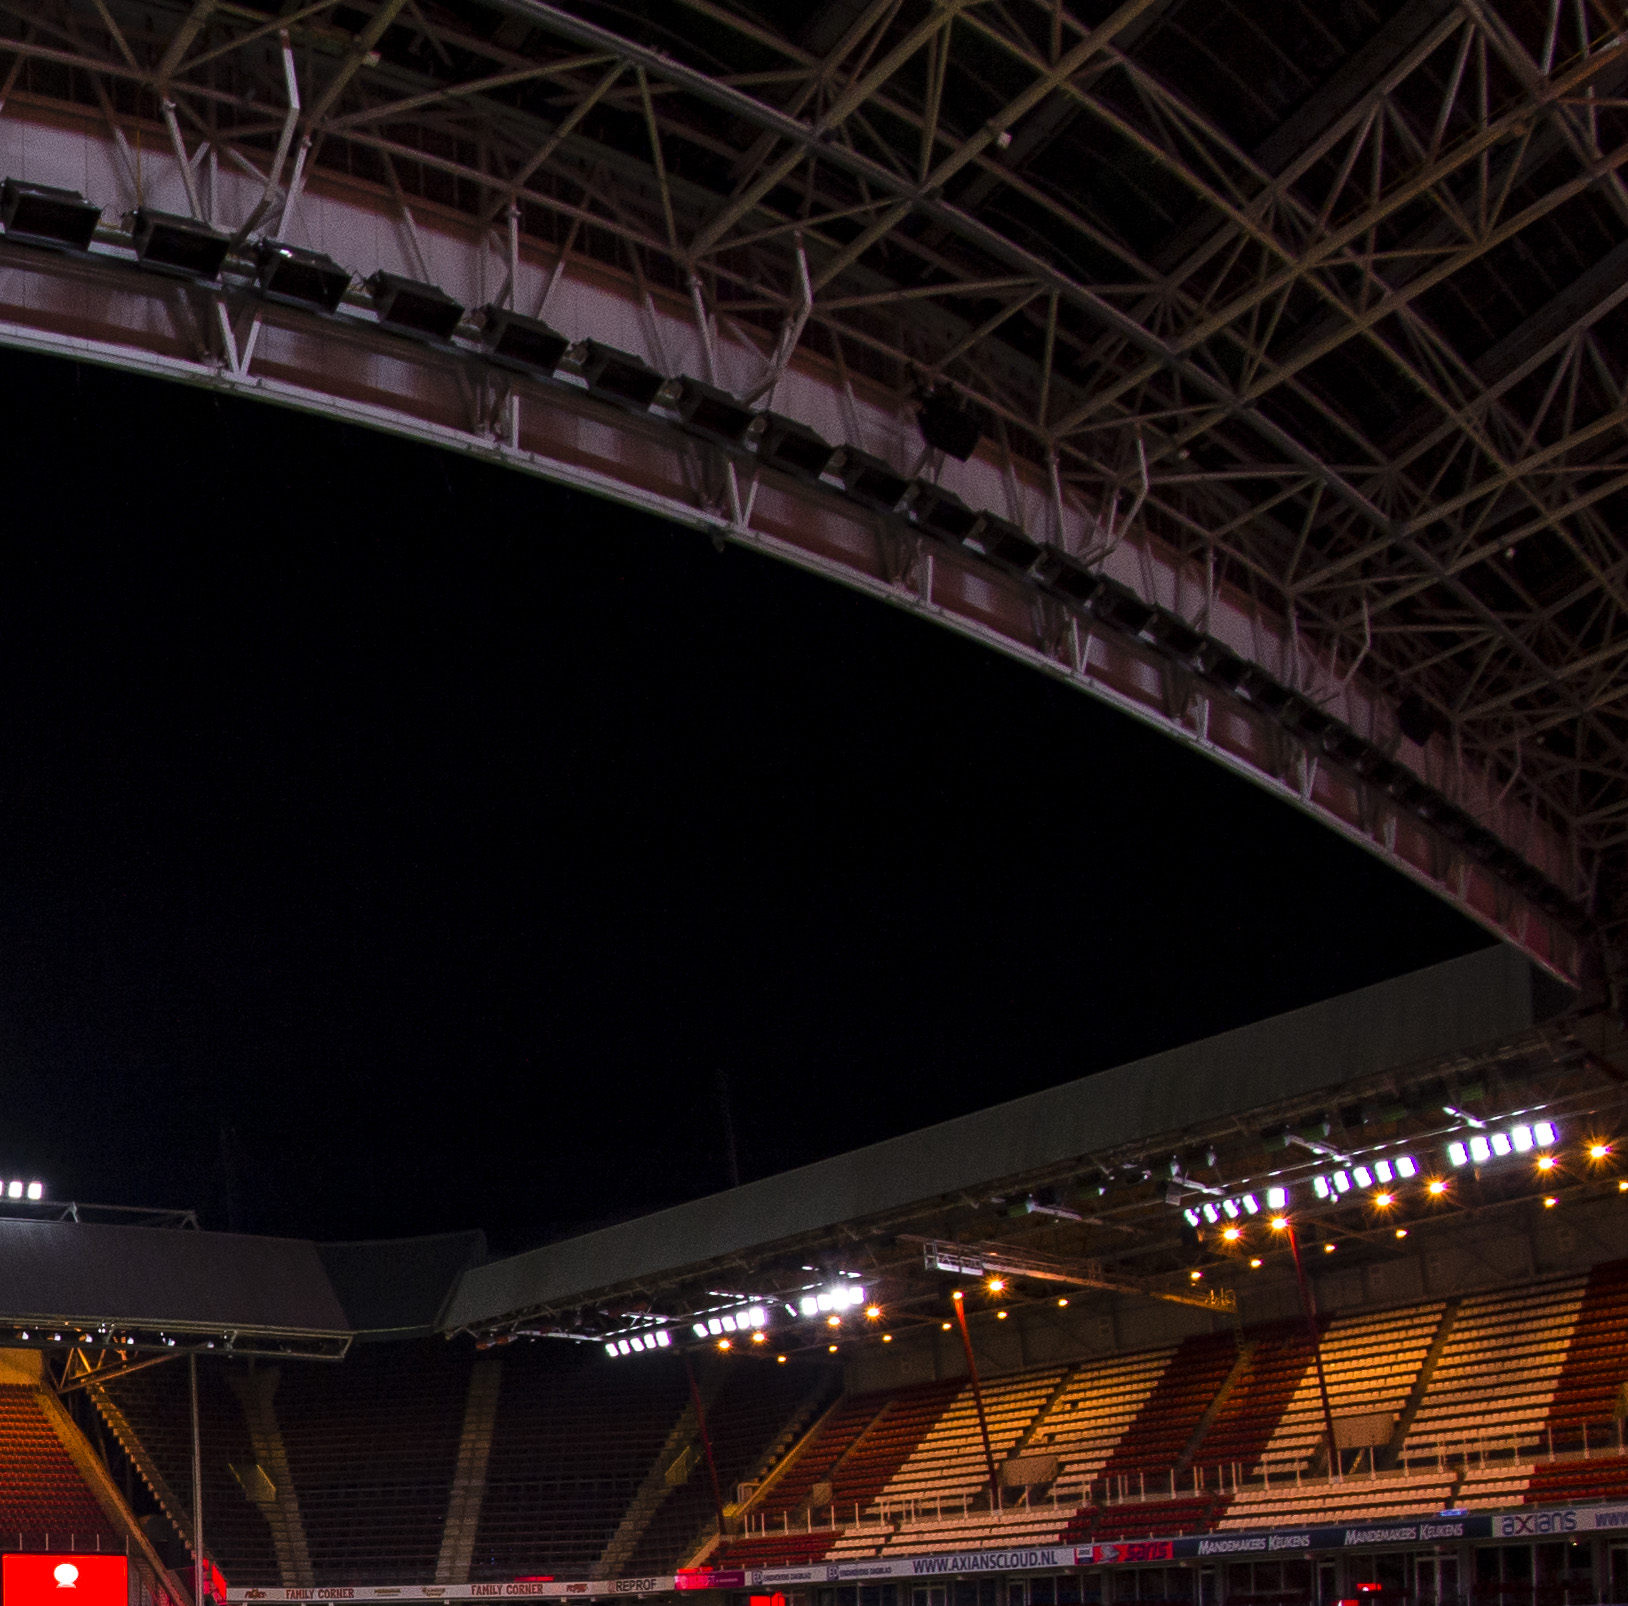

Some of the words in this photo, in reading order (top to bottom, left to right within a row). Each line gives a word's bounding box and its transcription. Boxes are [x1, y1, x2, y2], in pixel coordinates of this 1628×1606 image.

[913, 1550, 1058, 1574] WWW.AXIANSCLOUD.NL
[471, 1585, 503, 1596] FAMILY
[506, 1584, 543, 1594] CORNER
[616, 1579, 657, 1591] REPROF
[286, 1589, 314, 1600] FAMILY
[318, 1588, 355, 1599] CORNER
